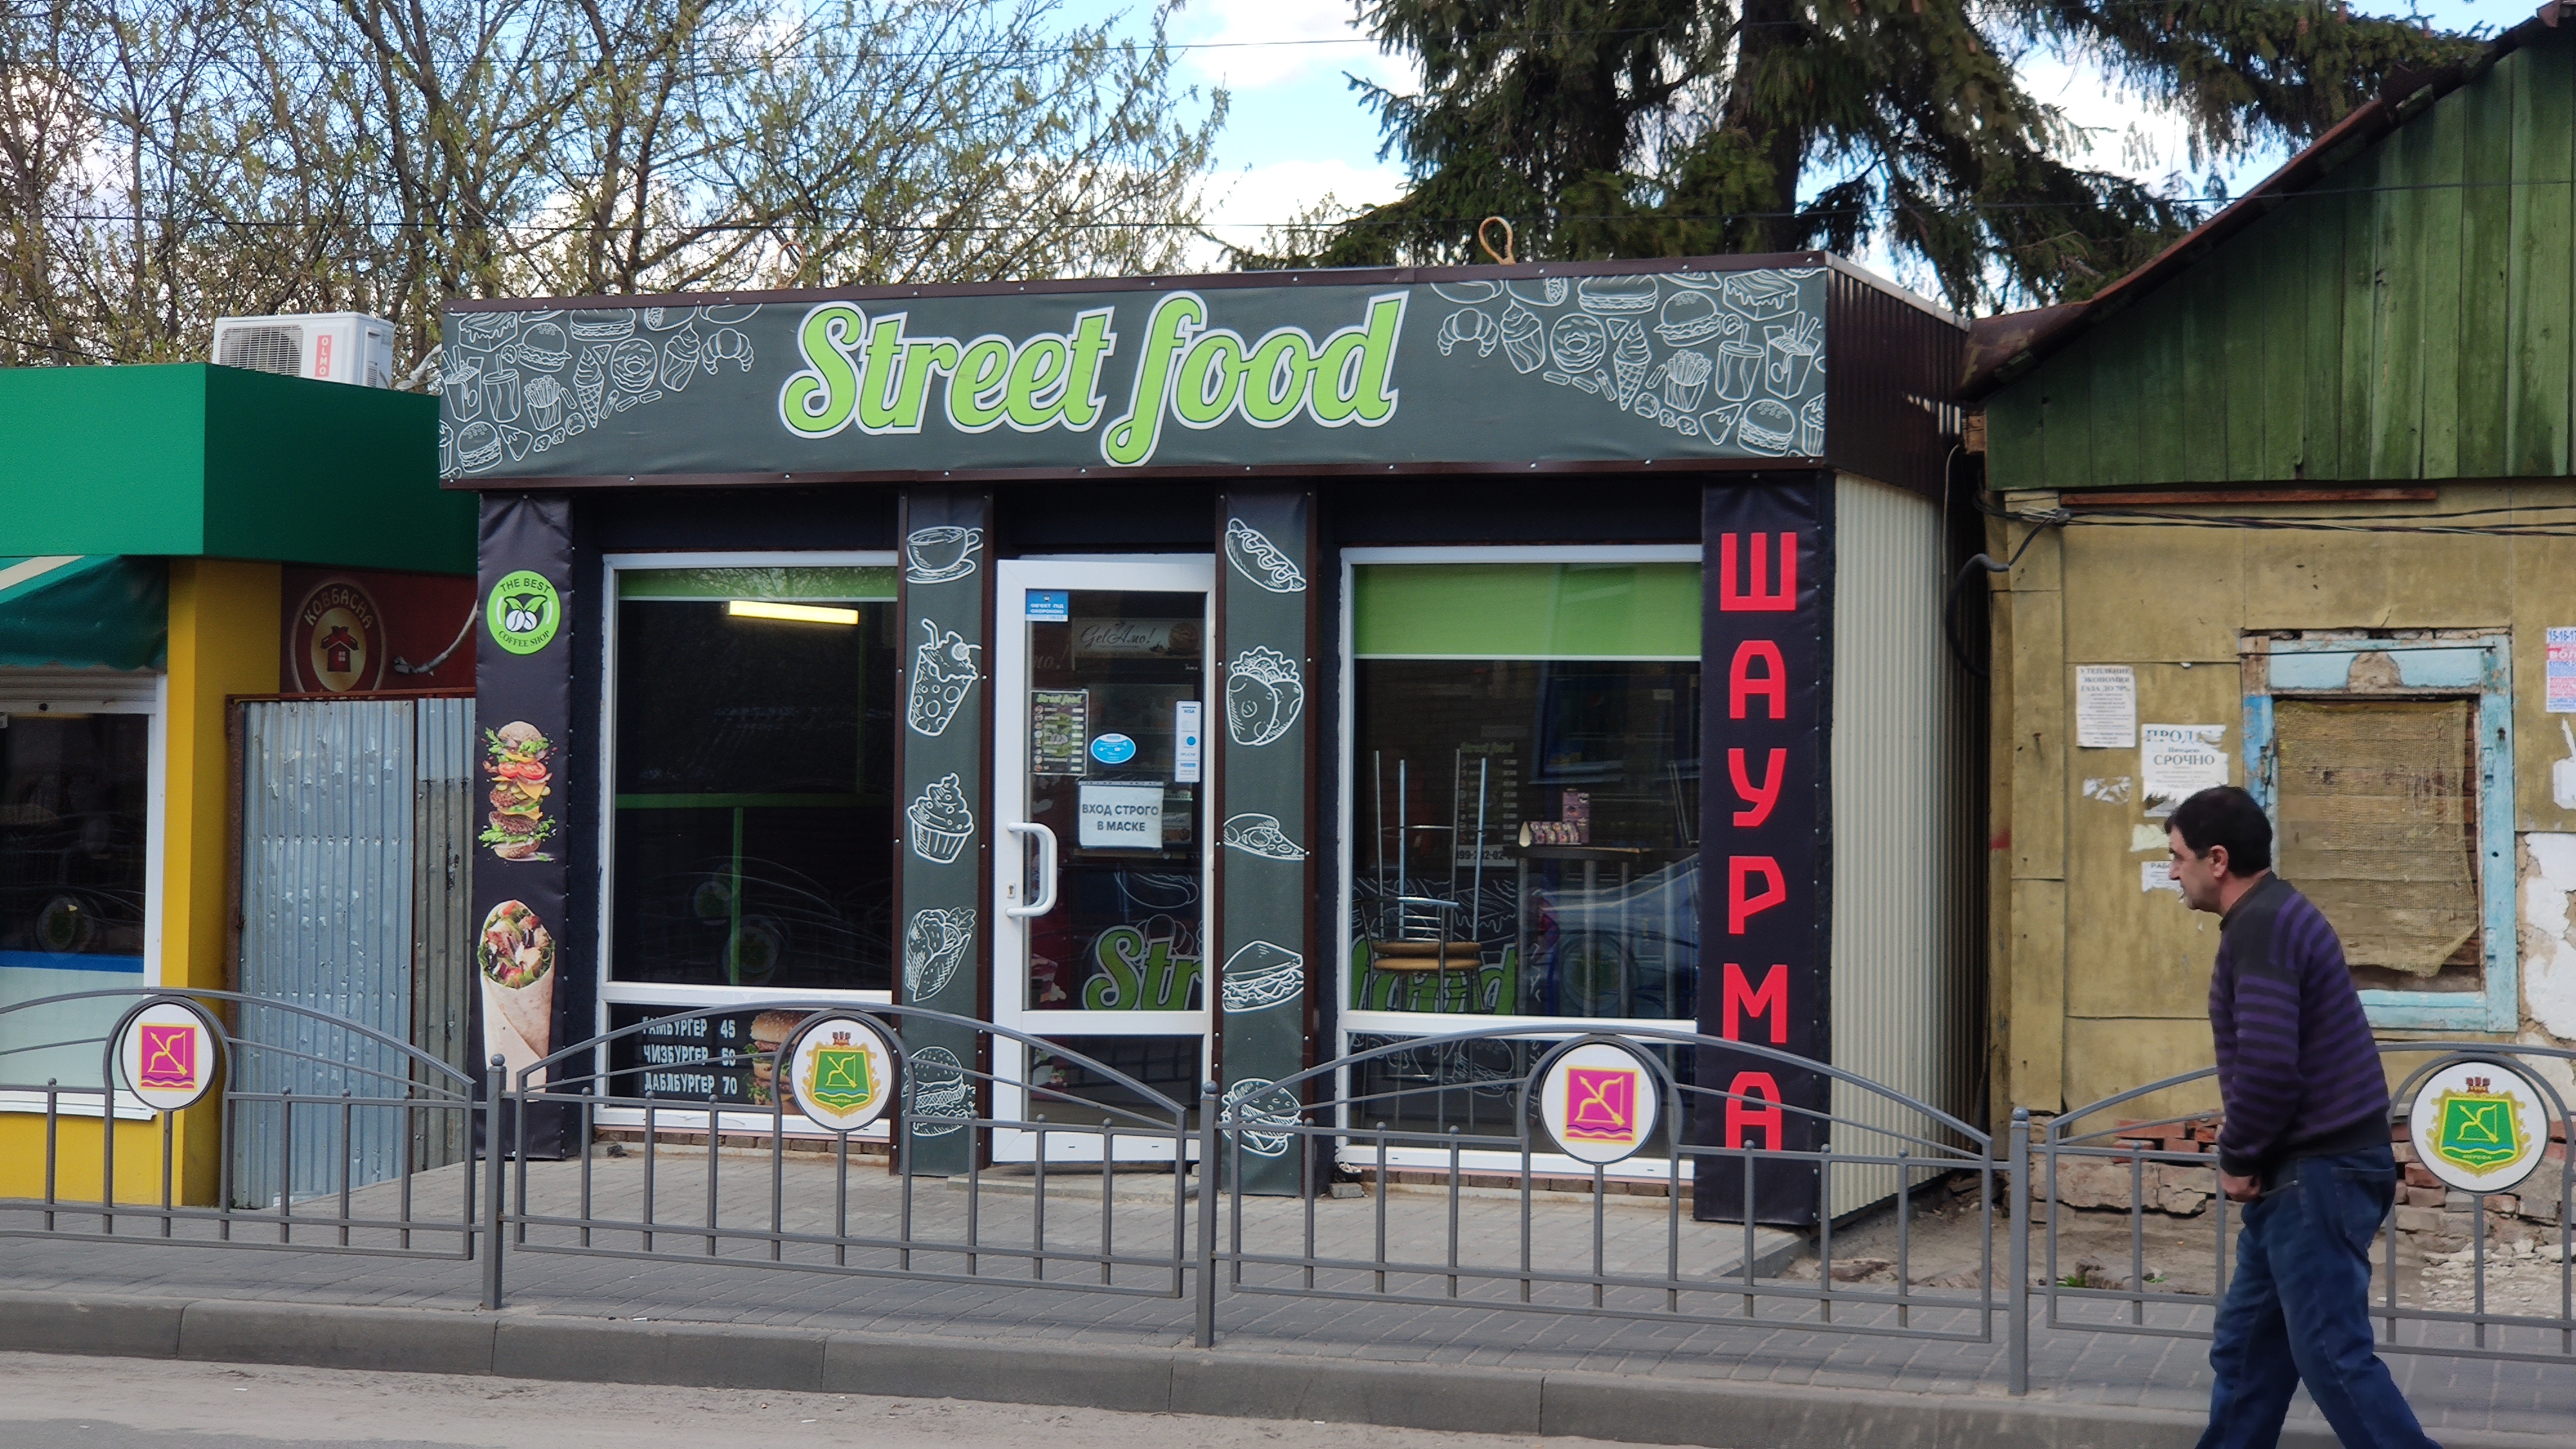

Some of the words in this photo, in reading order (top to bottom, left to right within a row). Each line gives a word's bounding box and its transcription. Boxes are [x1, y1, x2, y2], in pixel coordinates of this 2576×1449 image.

[319, 337, 329, 375] OLMO
[780, 300, 1117, 438] Street
[1101, 290, 1410, 468] food
[500, 578, 520, 592] THE
[524, 578, 551, 593] BEST
[498, 630, 529, 647] COFFEE
[530, 630, 549, 646] SHOP
[2154, 754, 2215, 766] СРОЧНО
[1082, 804, 1112, 816] ВХОД
[1115, 805, 1159, 816] СТРОГО
[1097, 821, 1104, 831] В
[1106, 822, 1146, 831] МАСКЕ
[1719, 532, 1796, 1151] ШАУРМА
[720, 1019, 735, 1038] 45
[643, 1044, 708, 1065] ЧИЗБУРГЕР
[645, 1072, 715, 1094] ДАБЛБУРГЕР
[723, 1076, 737, 1095] 70
